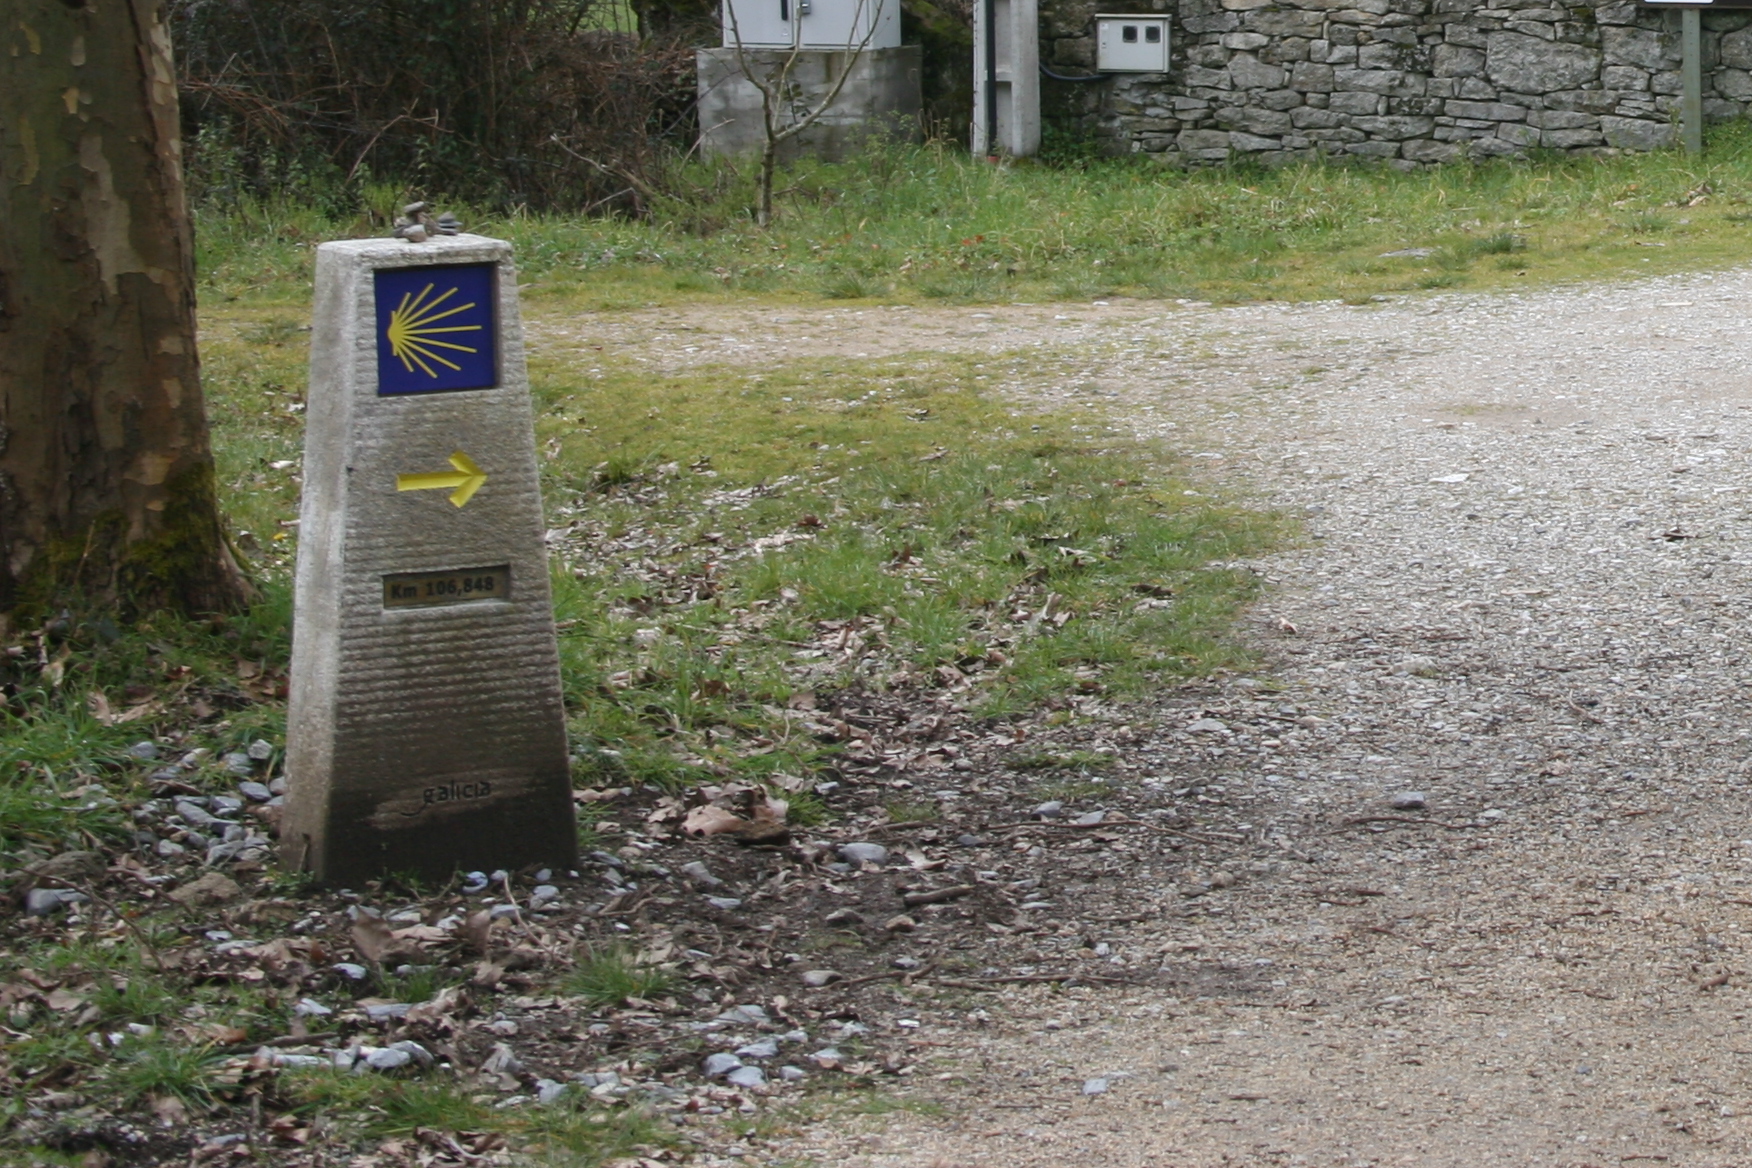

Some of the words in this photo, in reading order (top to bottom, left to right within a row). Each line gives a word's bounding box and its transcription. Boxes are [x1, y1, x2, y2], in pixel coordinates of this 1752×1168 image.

[391, 584, 417, 599] Km
[426, 576, 494, 597] 106,848
[420, 779, 491, 806] galicia
